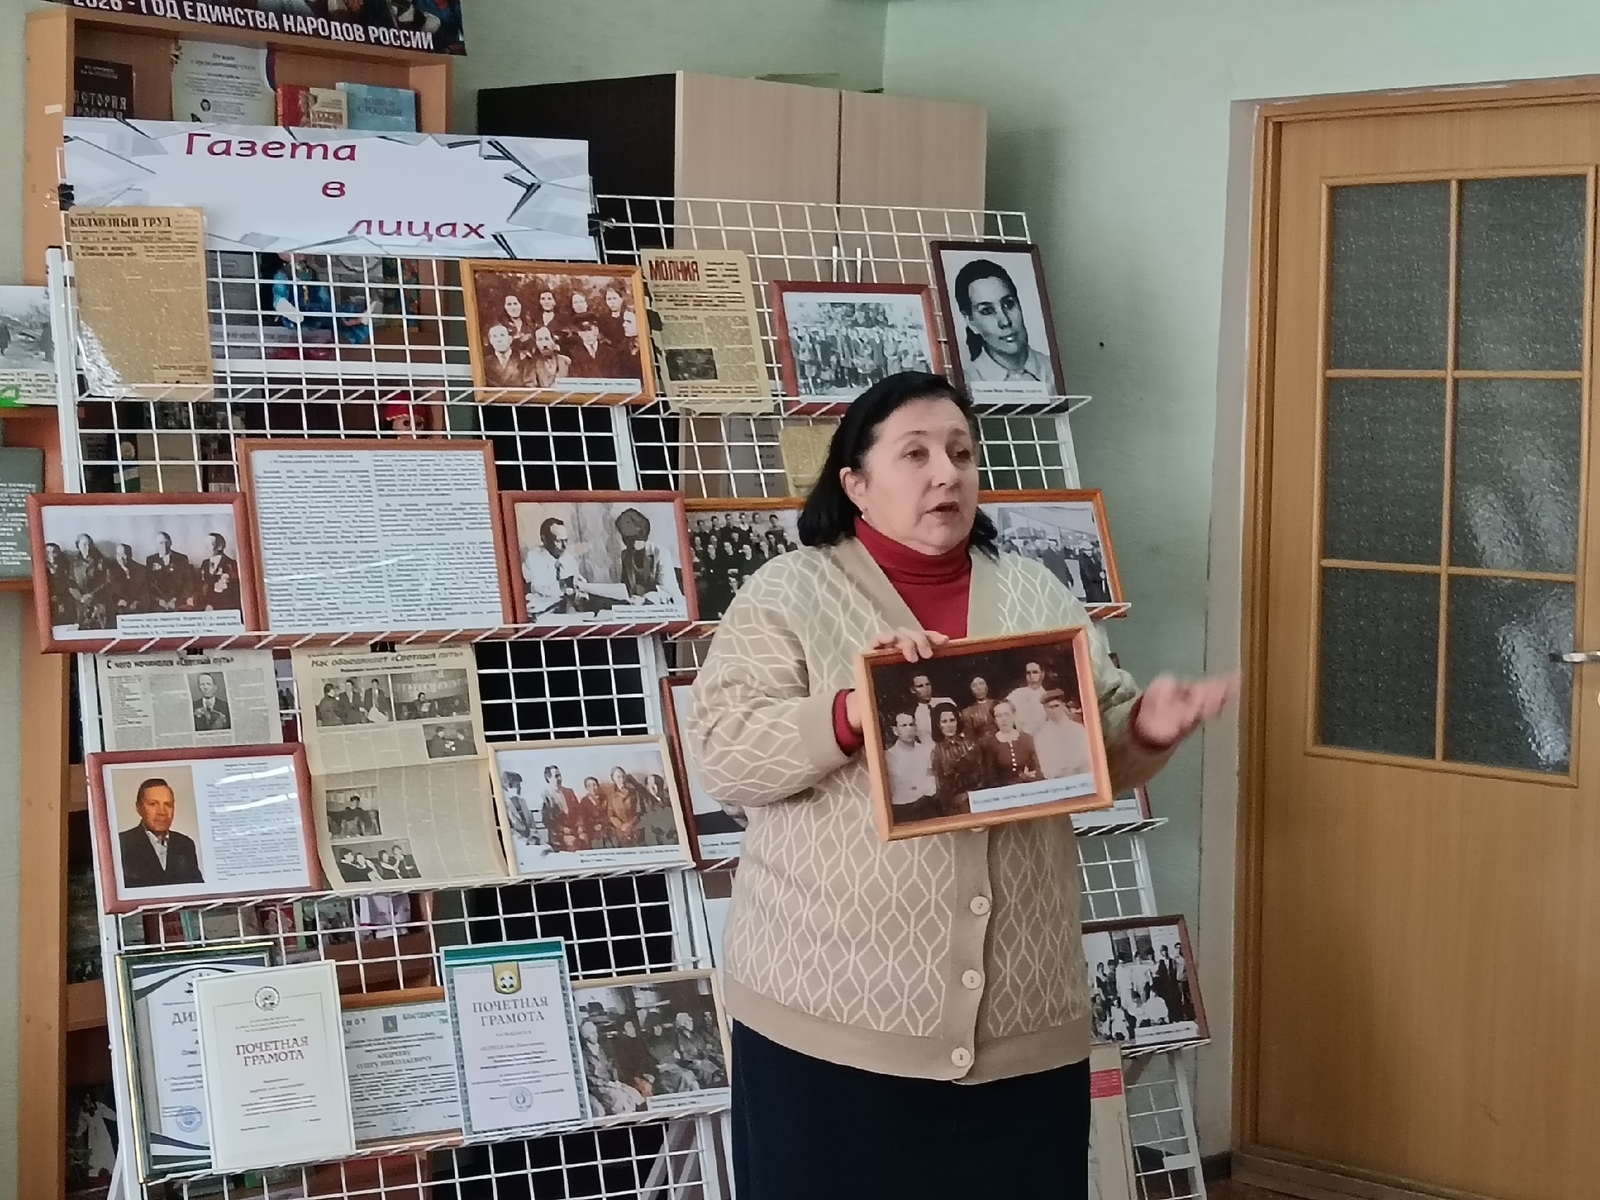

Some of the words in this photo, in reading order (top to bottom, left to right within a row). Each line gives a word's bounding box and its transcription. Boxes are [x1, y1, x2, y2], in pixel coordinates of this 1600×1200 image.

[140, 0, 182, 20] ГОД
[183, 8, 280, 31] ЕДИНСТВА
[282, 13, 366, 42] НАРОДОВ
[368, 25, 435, 50] РОССИИ
[185, 132, 358, 162] Газета
[321, 180, 347, 198] в
[69, 216, 140, 228] КОЛХОЗНЫЙ
[141, 216, 173, 228] ТРУД
[346, 218, 486, 243] лицах
[648, 259, 701, 283] МОЛНИЯ
[472, 995, 550, 1014] ПОЧЕТНАЯ
[480, 1010, 546, 1027] ГРАМОТА
[235, 1035, 310, 1056] ПОЧЕТНАЯ
[243, 1048, 306, 1067] ГРАМОТА
